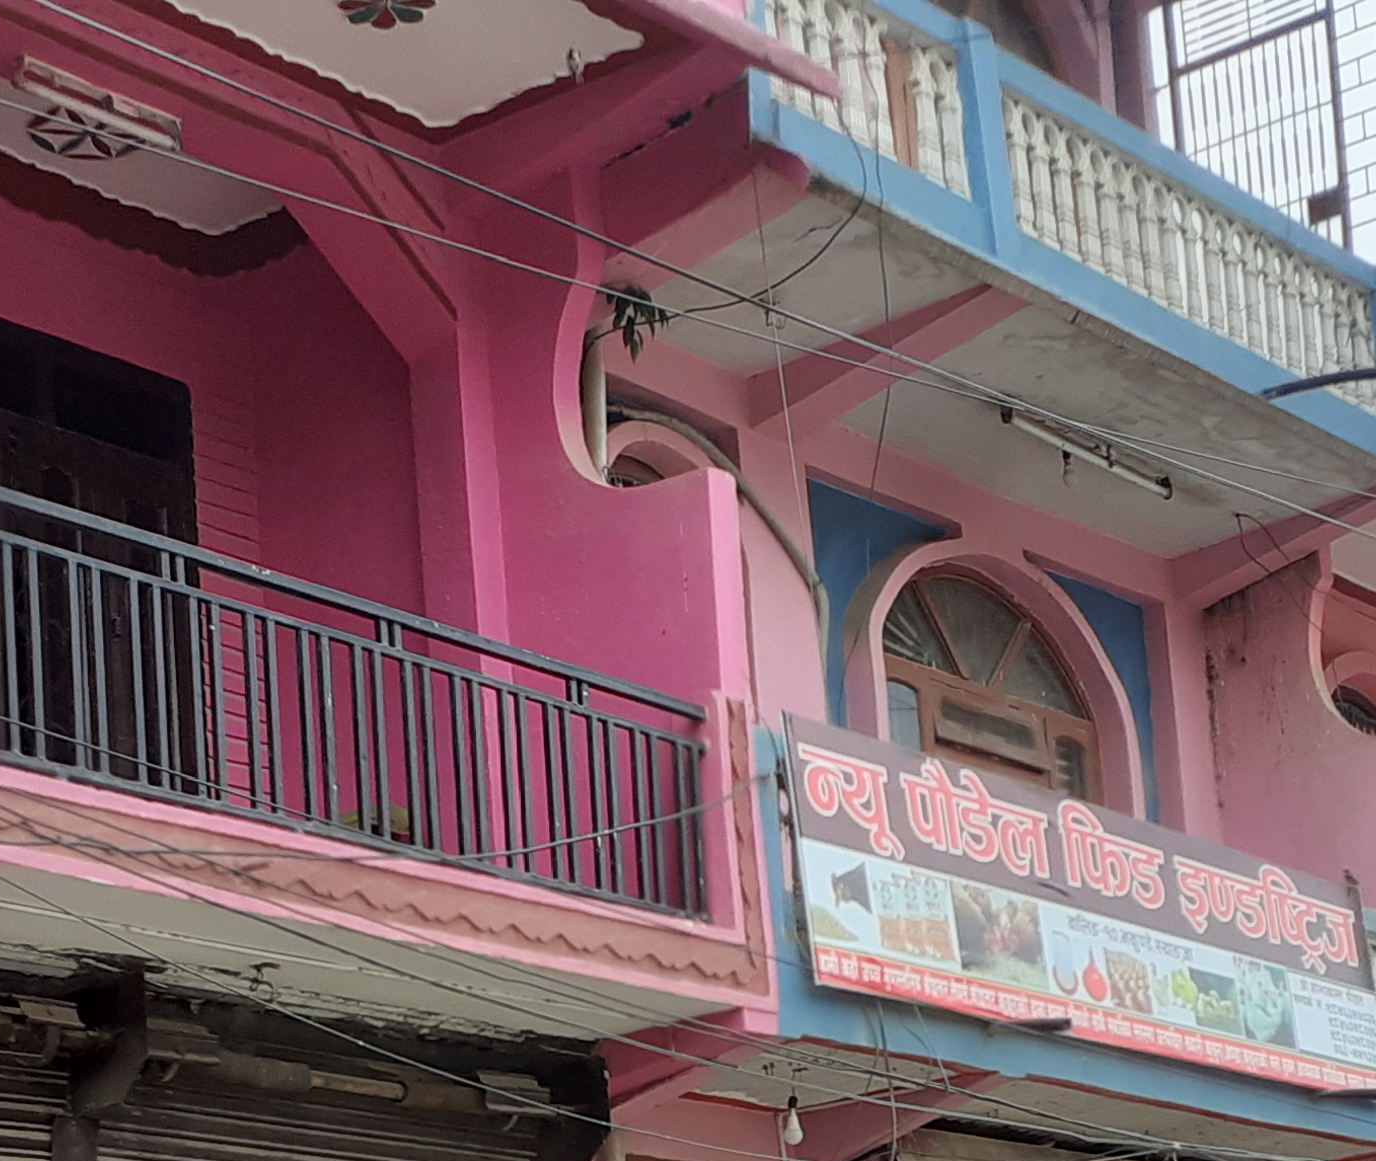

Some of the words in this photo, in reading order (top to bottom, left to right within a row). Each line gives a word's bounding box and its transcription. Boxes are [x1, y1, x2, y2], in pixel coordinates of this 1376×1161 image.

[797, 742, 904, 861] न्यू
[900, 758, 1050, 879] पौडेल
[1057, 799, 1165, 909] फिड
